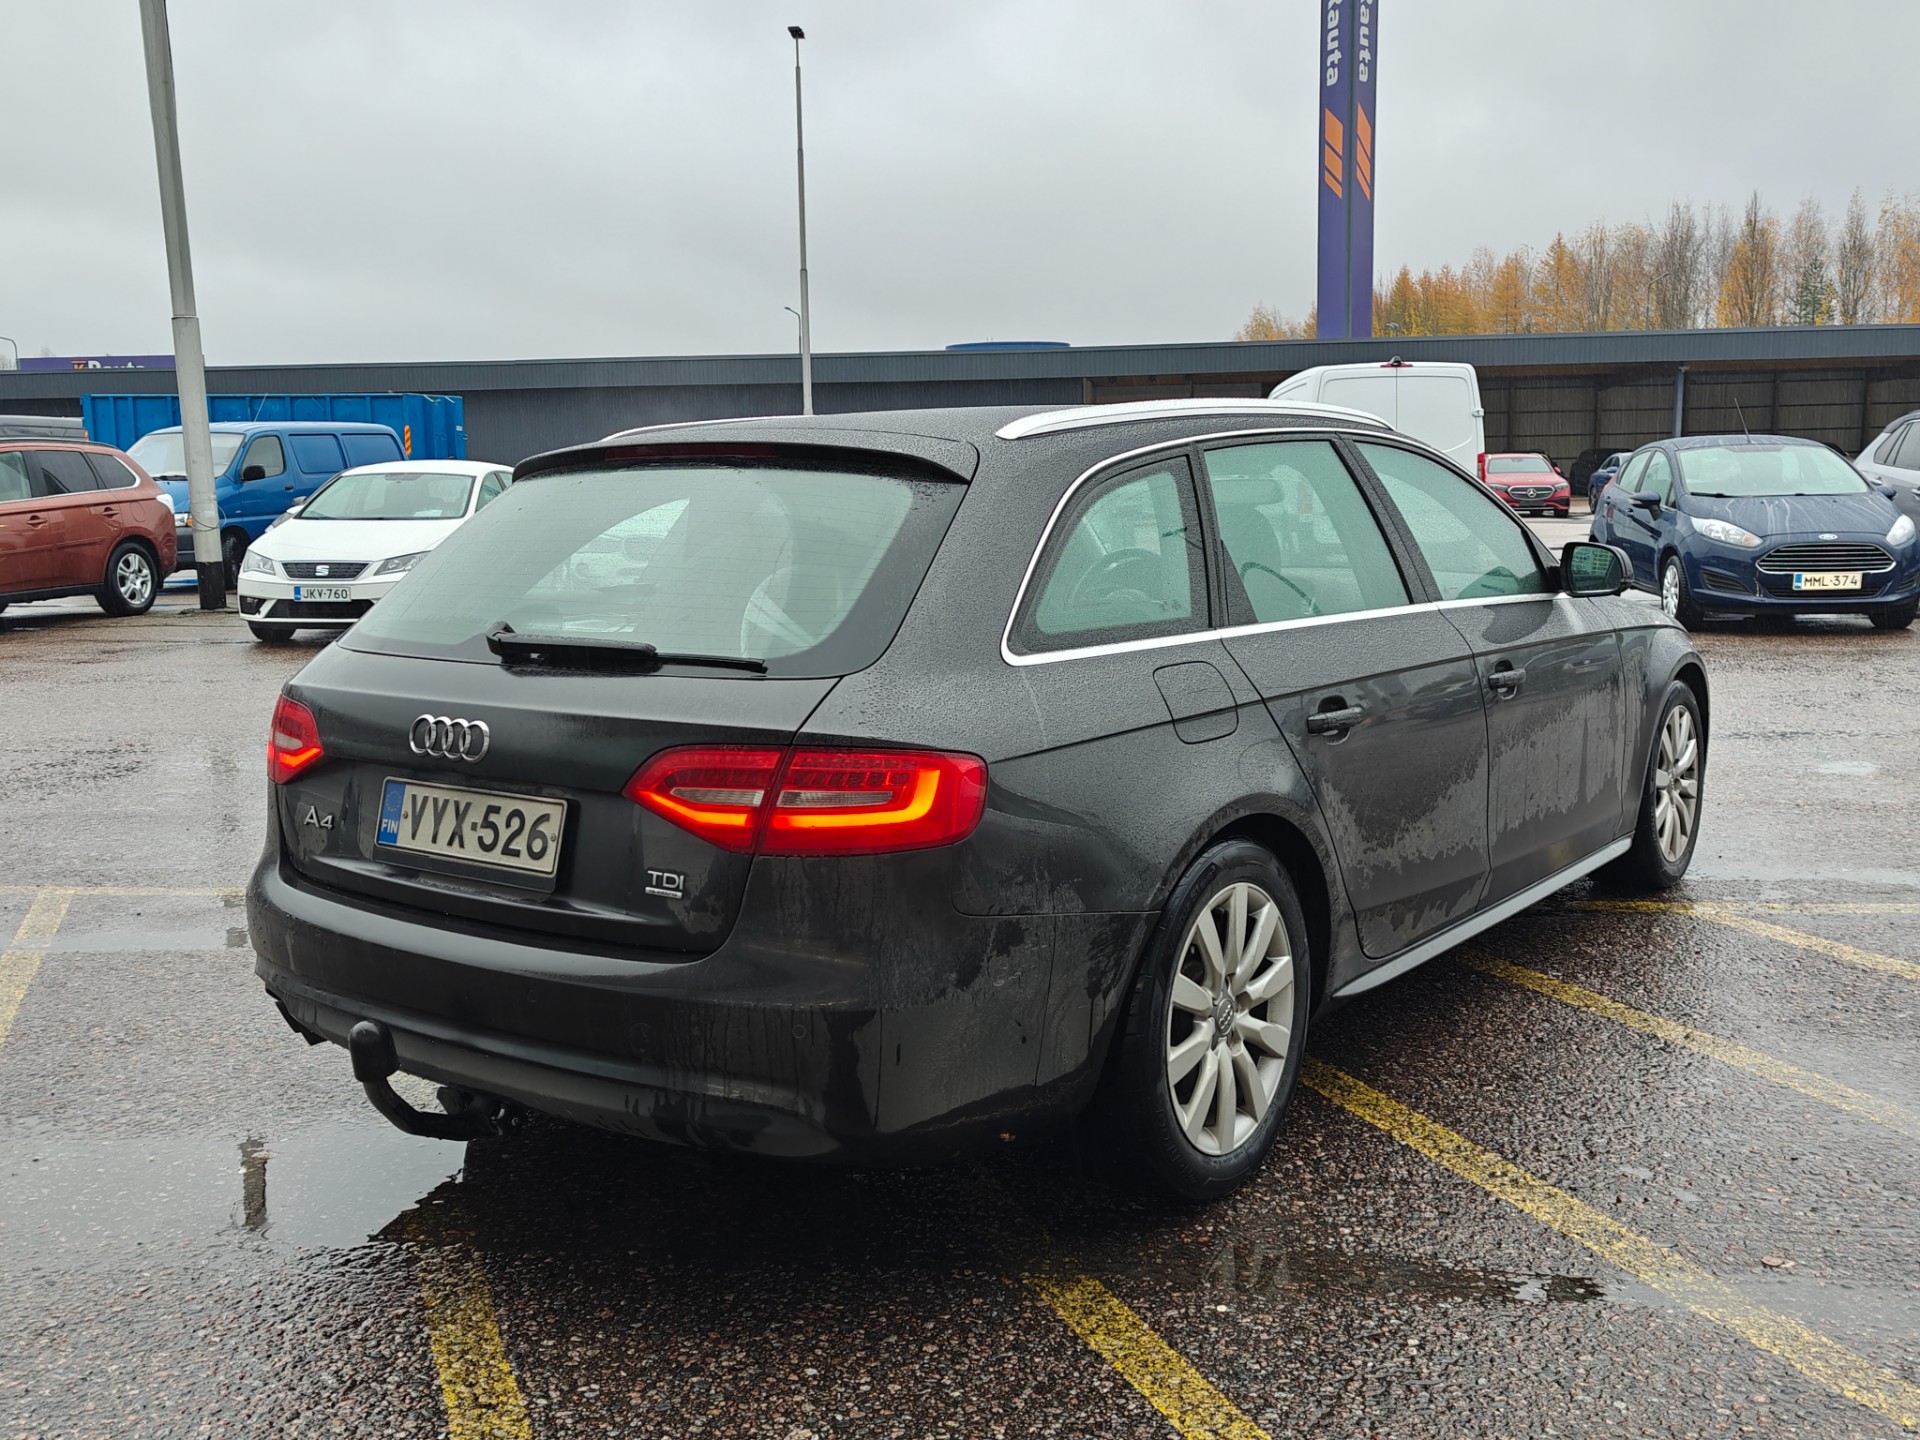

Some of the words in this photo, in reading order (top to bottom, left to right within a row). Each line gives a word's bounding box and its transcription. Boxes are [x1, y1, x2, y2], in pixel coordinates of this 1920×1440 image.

[1359, 0, 1373, 82] auta
[303, 805, 333, 829] A4
[381, 818, 400, 834] FIN
[411, 793, 551, 861] VYX-526
[647, 870, 684, 890] TDI
